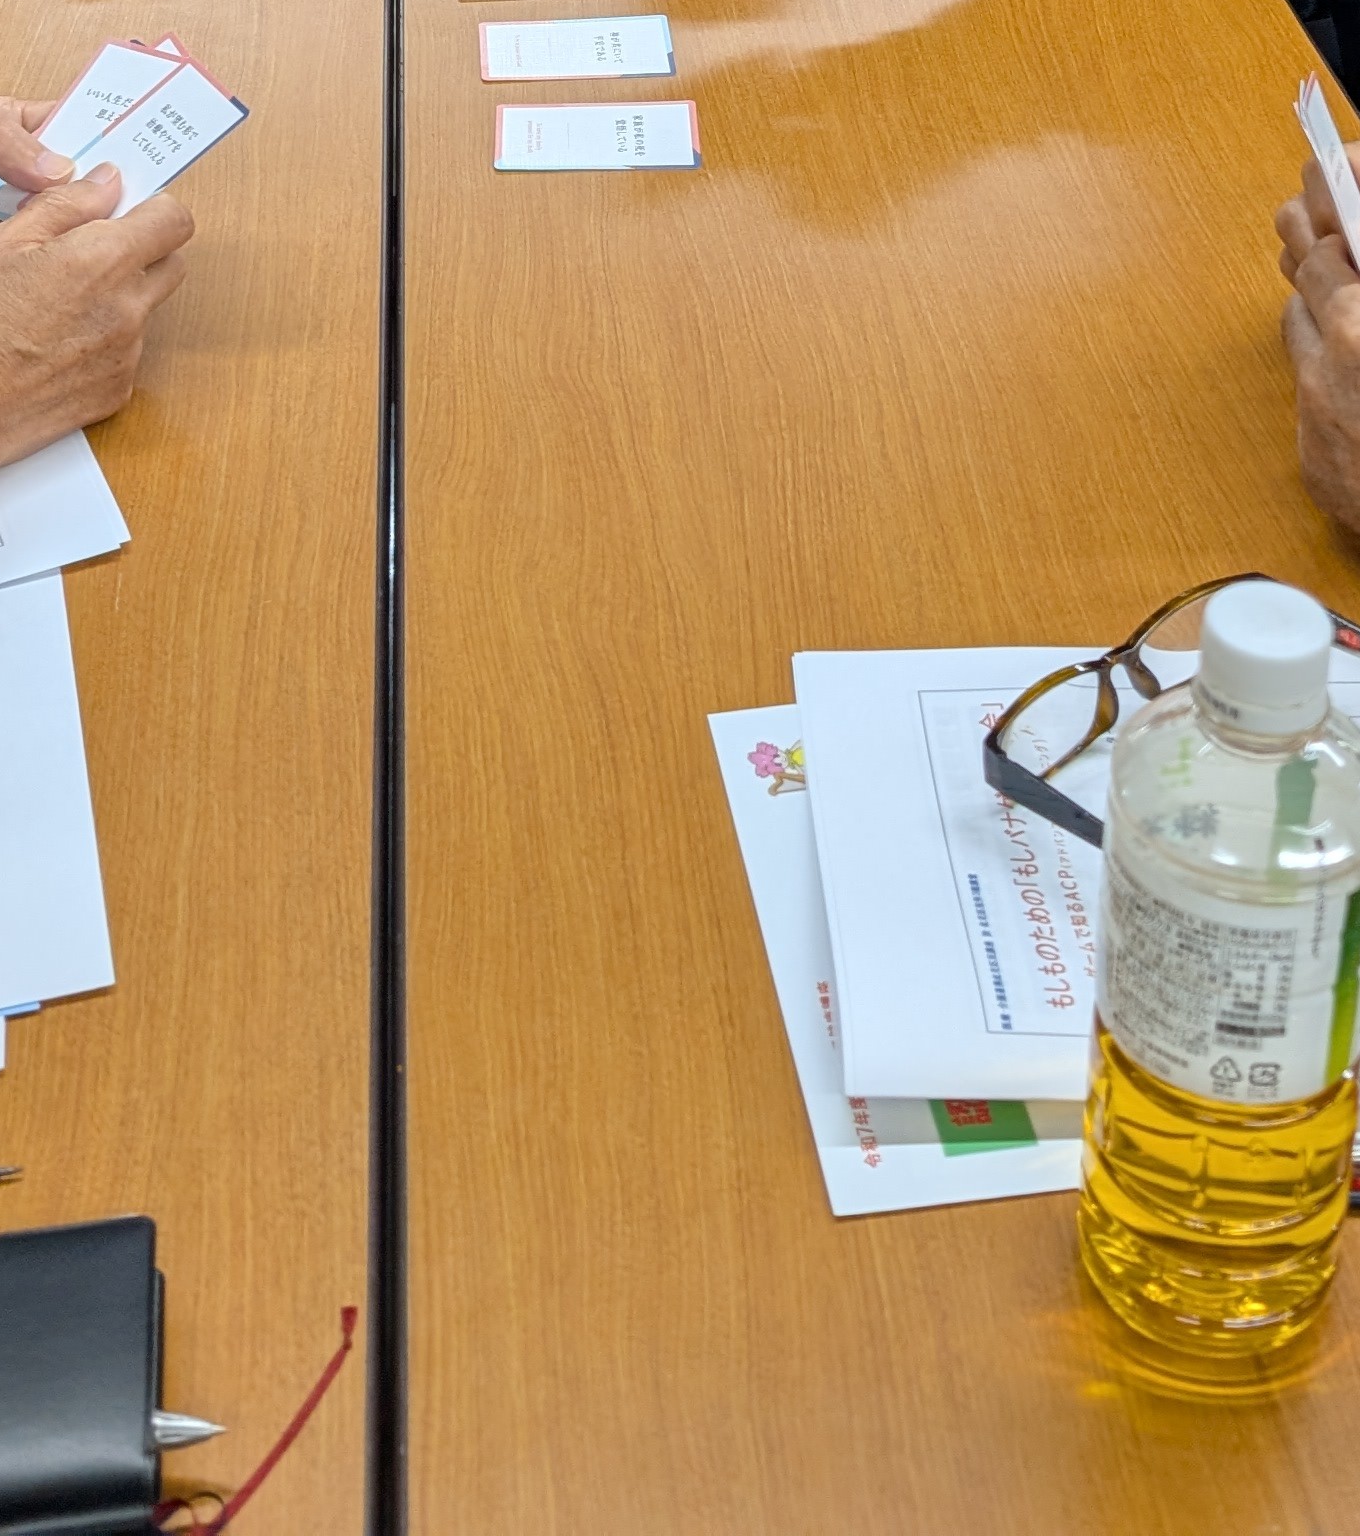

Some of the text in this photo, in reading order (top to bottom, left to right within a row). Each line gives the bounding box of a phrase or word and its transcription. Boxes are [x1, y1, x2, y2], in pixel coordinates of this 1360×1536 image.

[132, 132, 166, 166] してもらえる
